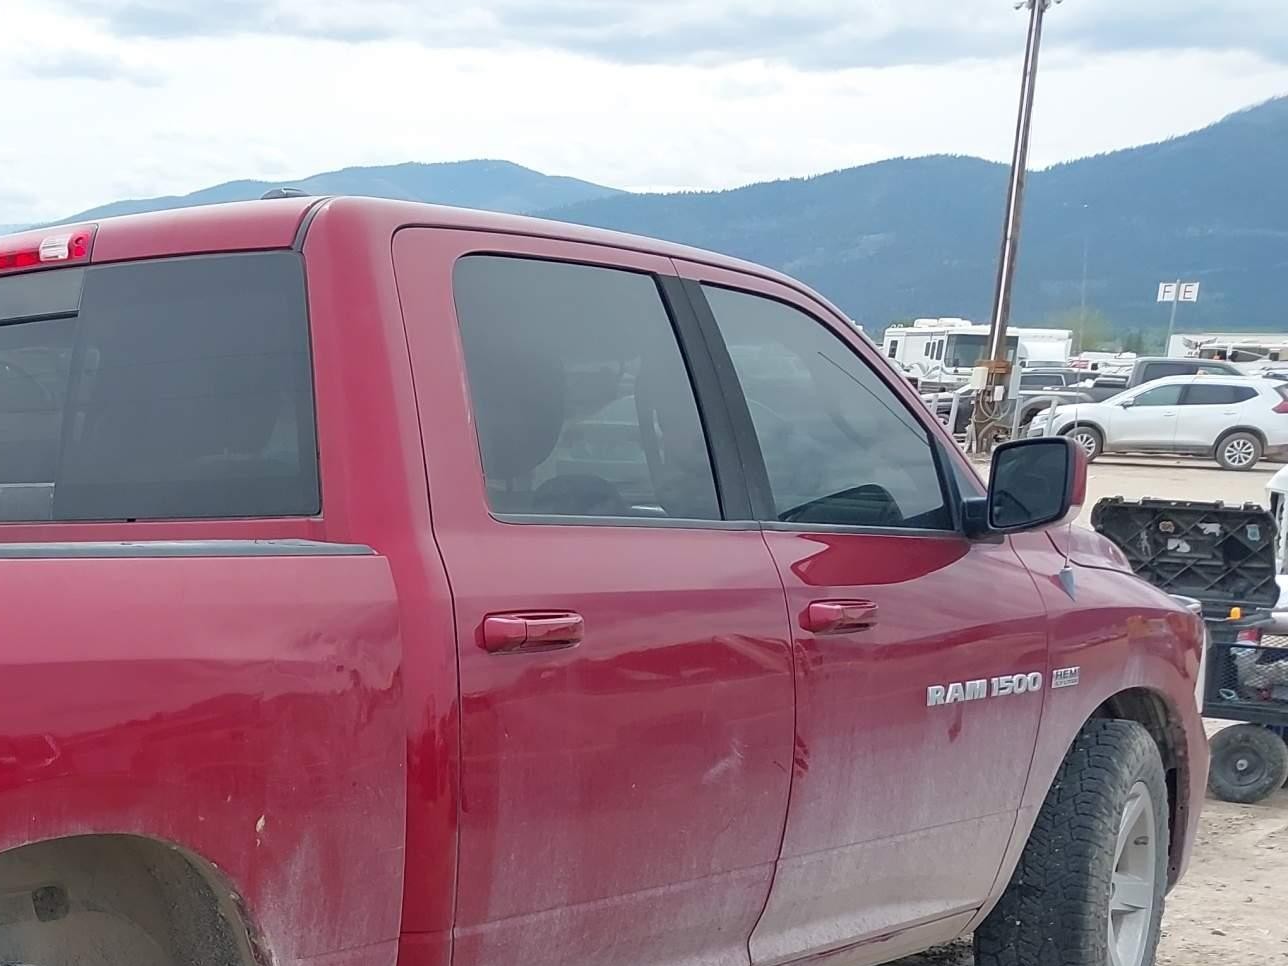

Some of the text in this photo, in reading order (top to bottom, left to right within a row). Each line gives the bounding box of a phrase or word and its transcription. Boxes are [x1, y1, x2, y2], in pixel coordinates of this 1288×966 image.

[1162, 284, 1174, 300] F
[1183, 284, 1194, 300] E
[927, 672, 1043, 707] RAM 1500
